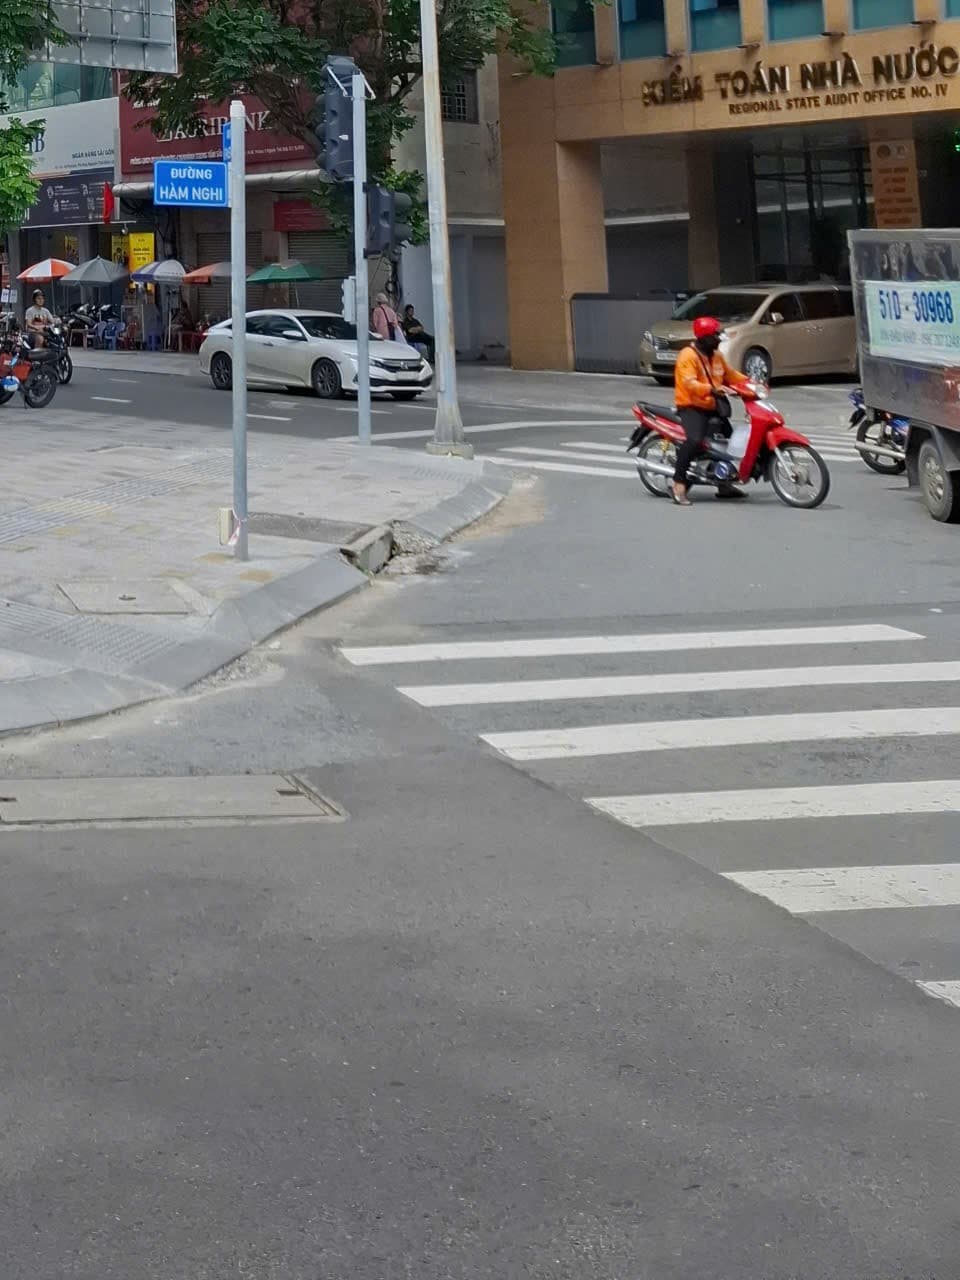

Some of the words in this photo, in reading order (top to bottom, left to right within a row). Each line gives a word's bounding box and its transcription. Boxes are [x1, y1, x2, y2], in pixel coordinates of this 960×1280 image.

[715, 61, 790, 99] TOÁN
[800, 52, 863, 90] NHÀ
[873, 40, 959, 84] NƯỚC
[729, 99, 782, 115] REGIONAL
[786, 96, 820, 111] STATE
[825, 92, 859, 106] AUDIT
[863, 88, 905, 103] OFFICE
[912, 86, 931, 98] NO.
[935, 84, 948, 96] IV
[170, 166, 212, 180] ĐƯỜNG
[160, 182, 188, 200] HÀM
[192, 186, 223, 200] NGHI
[879, 289, 902, 321] 51D
[912, 291, 954, 324] 30968
